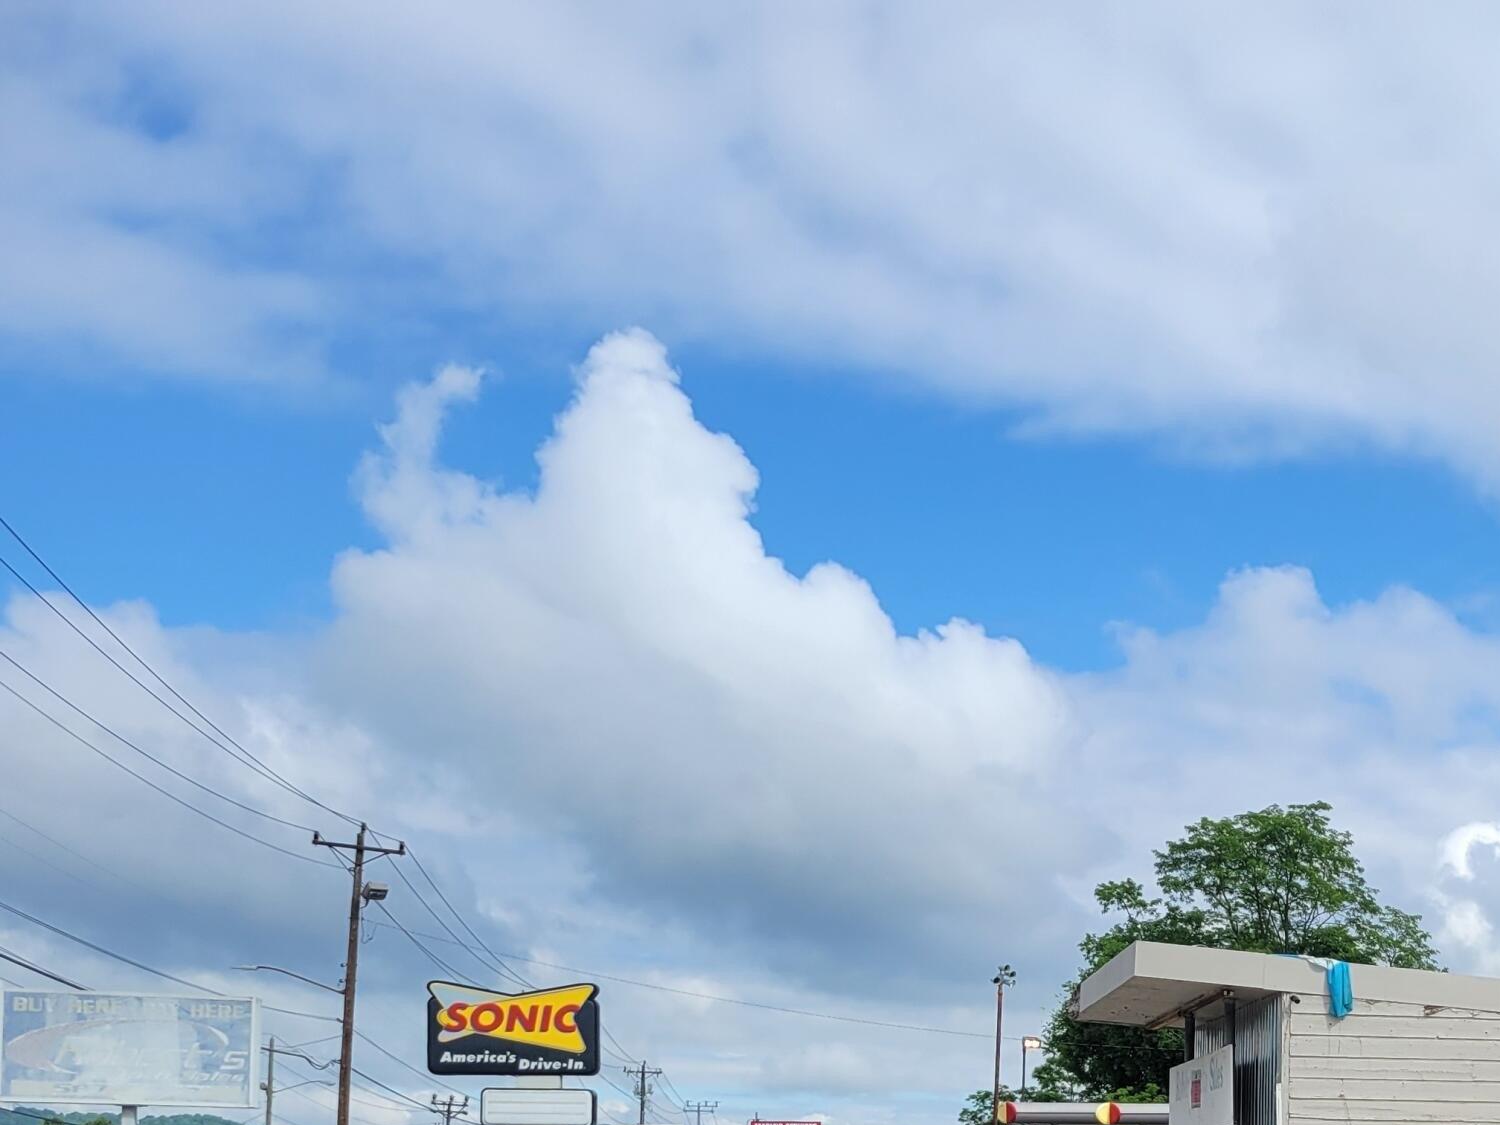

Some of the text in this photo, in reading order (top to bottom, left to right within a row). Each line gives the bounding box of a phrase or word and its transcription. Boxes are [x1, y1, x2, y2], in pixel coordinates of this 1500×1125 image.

[443, 1002, 581, 1034] SONIC
[440, 1050, 584, 1071] America's Drive-In
